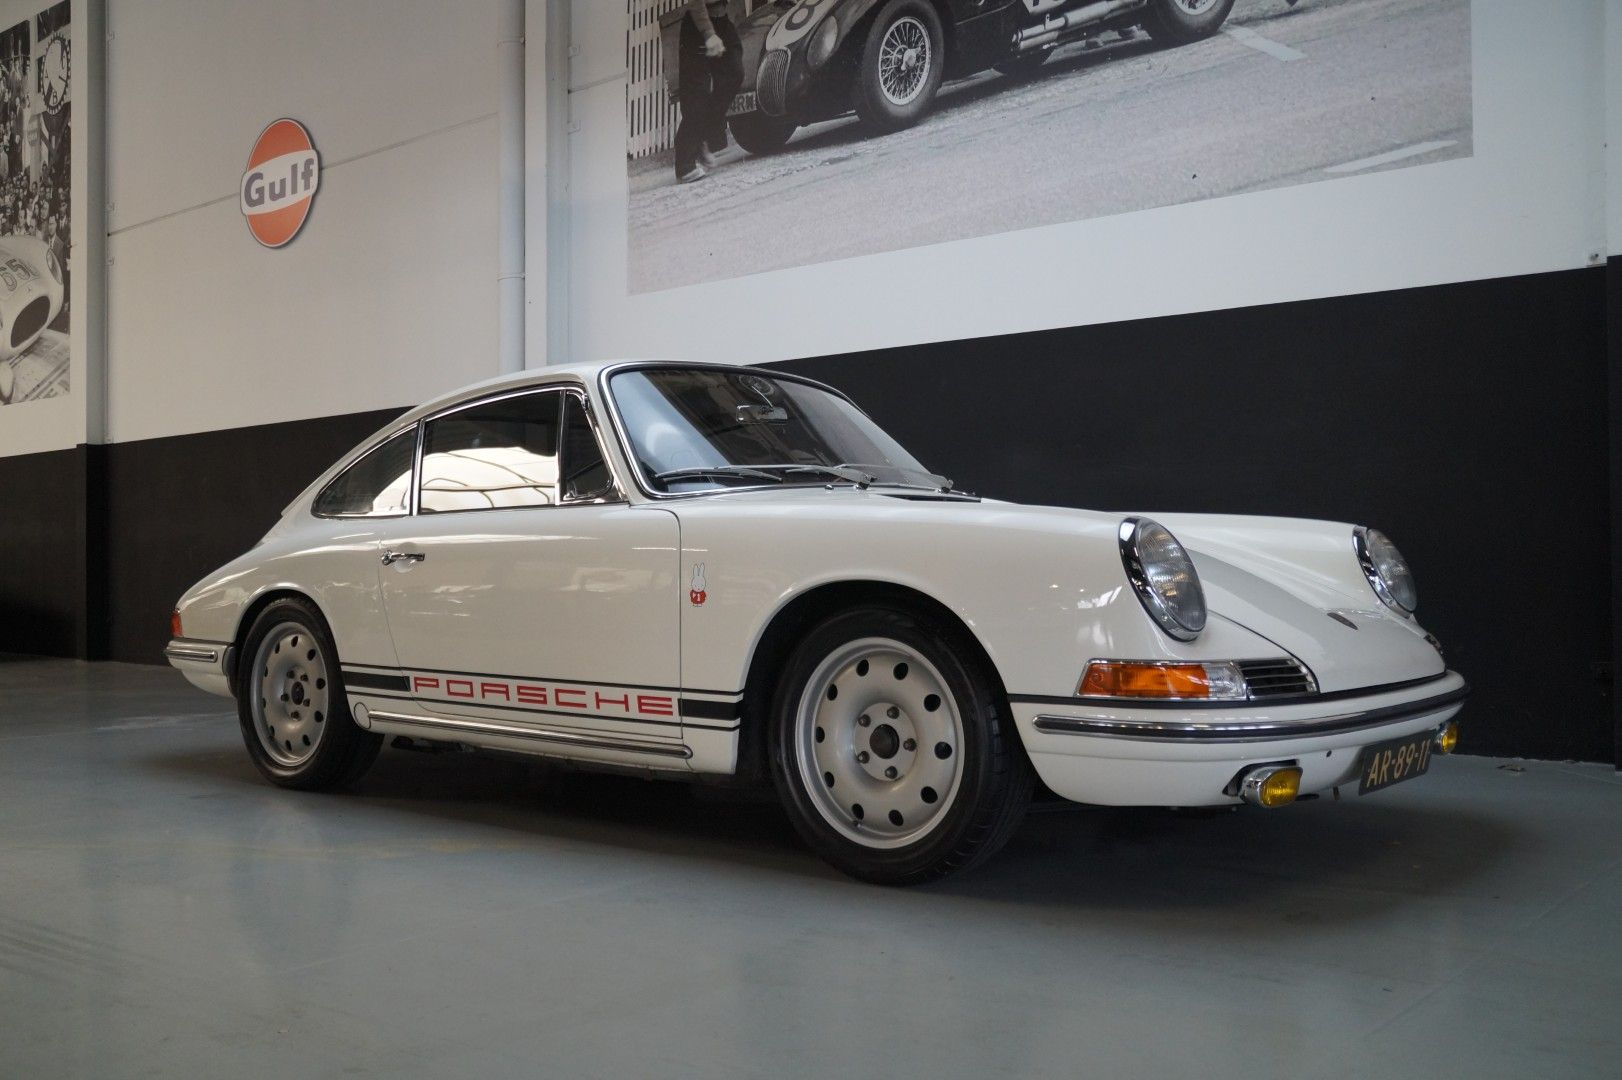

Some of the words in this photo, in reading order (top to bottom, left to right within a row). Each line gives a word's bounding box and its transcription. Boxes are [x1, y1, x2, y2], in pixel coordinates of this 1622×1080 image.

[244, 158, 314, 208] Gulf
[413, 676, 675, 716] PORSCHE
[1366, 740, 1431, 788] AR-89-11
